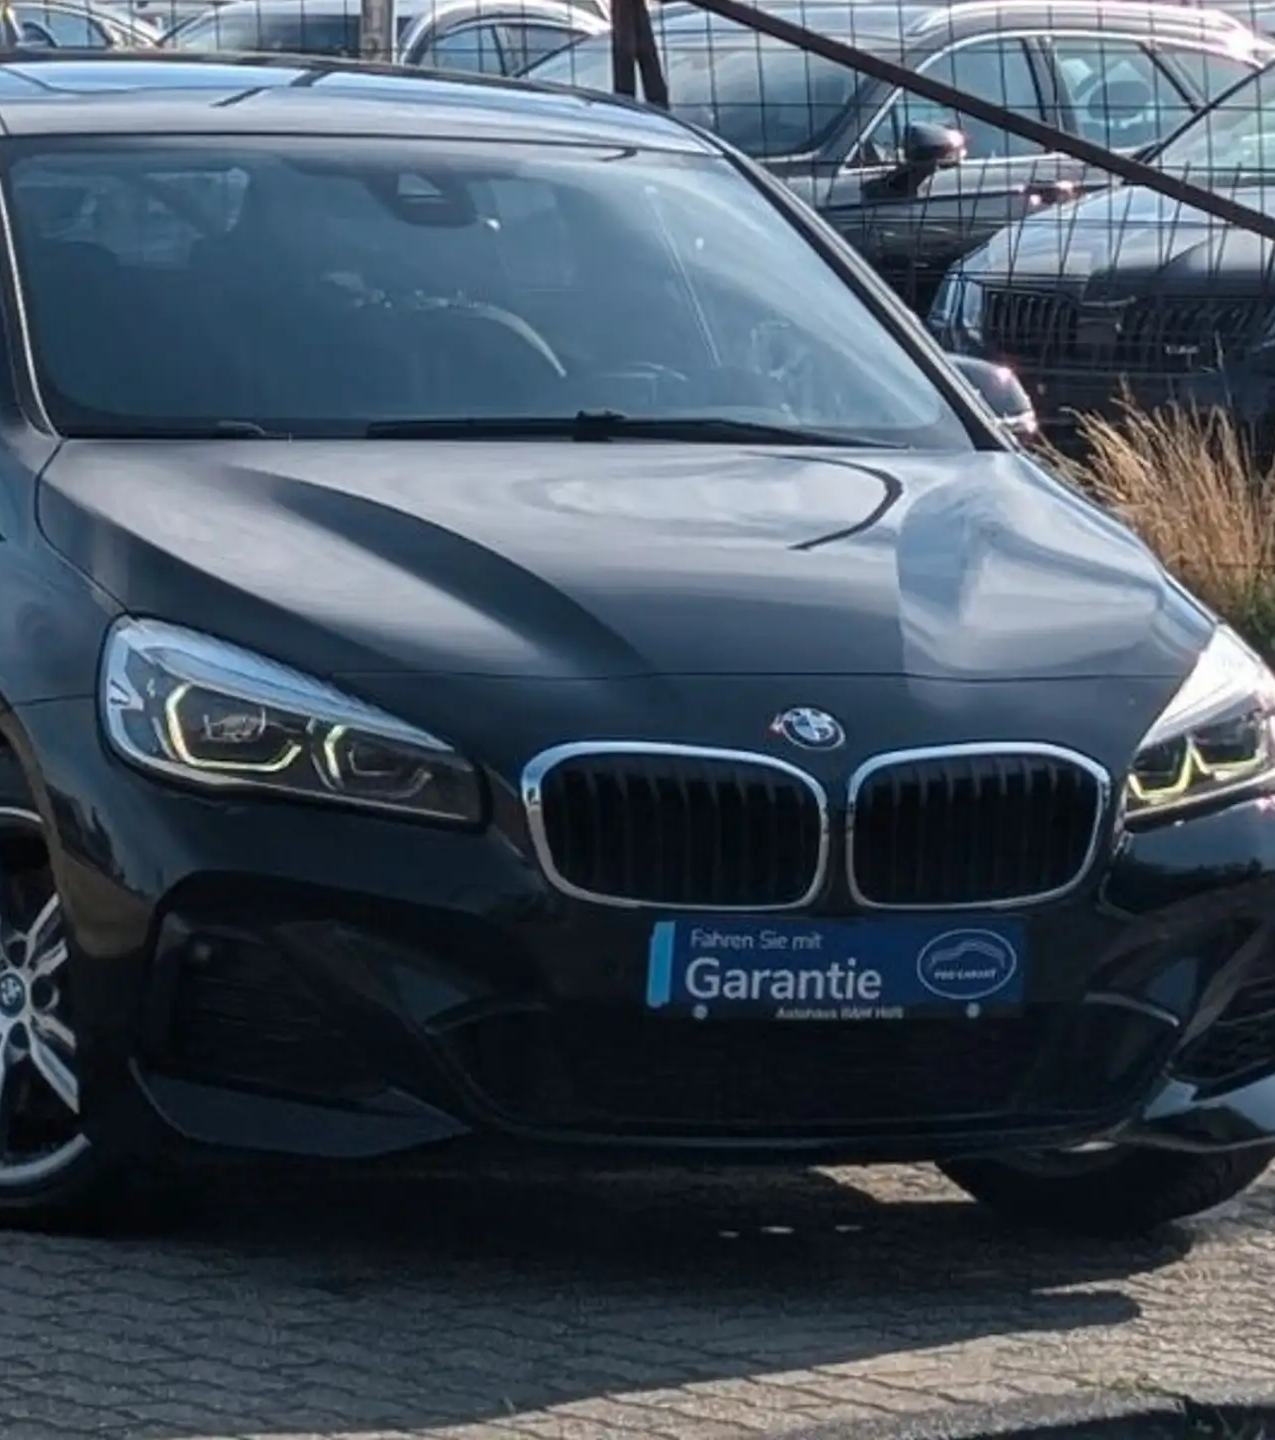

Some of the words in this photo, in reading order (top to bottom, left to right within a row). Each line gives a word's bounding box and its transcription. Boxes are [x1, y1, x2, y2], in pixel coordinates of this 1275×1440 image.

[690, 929, 754, 950] Fahren
[760, 930, 789, 949] Sie
[792, 932, 823, 950] mit
[685, 957, 883, 1000] Garantie
